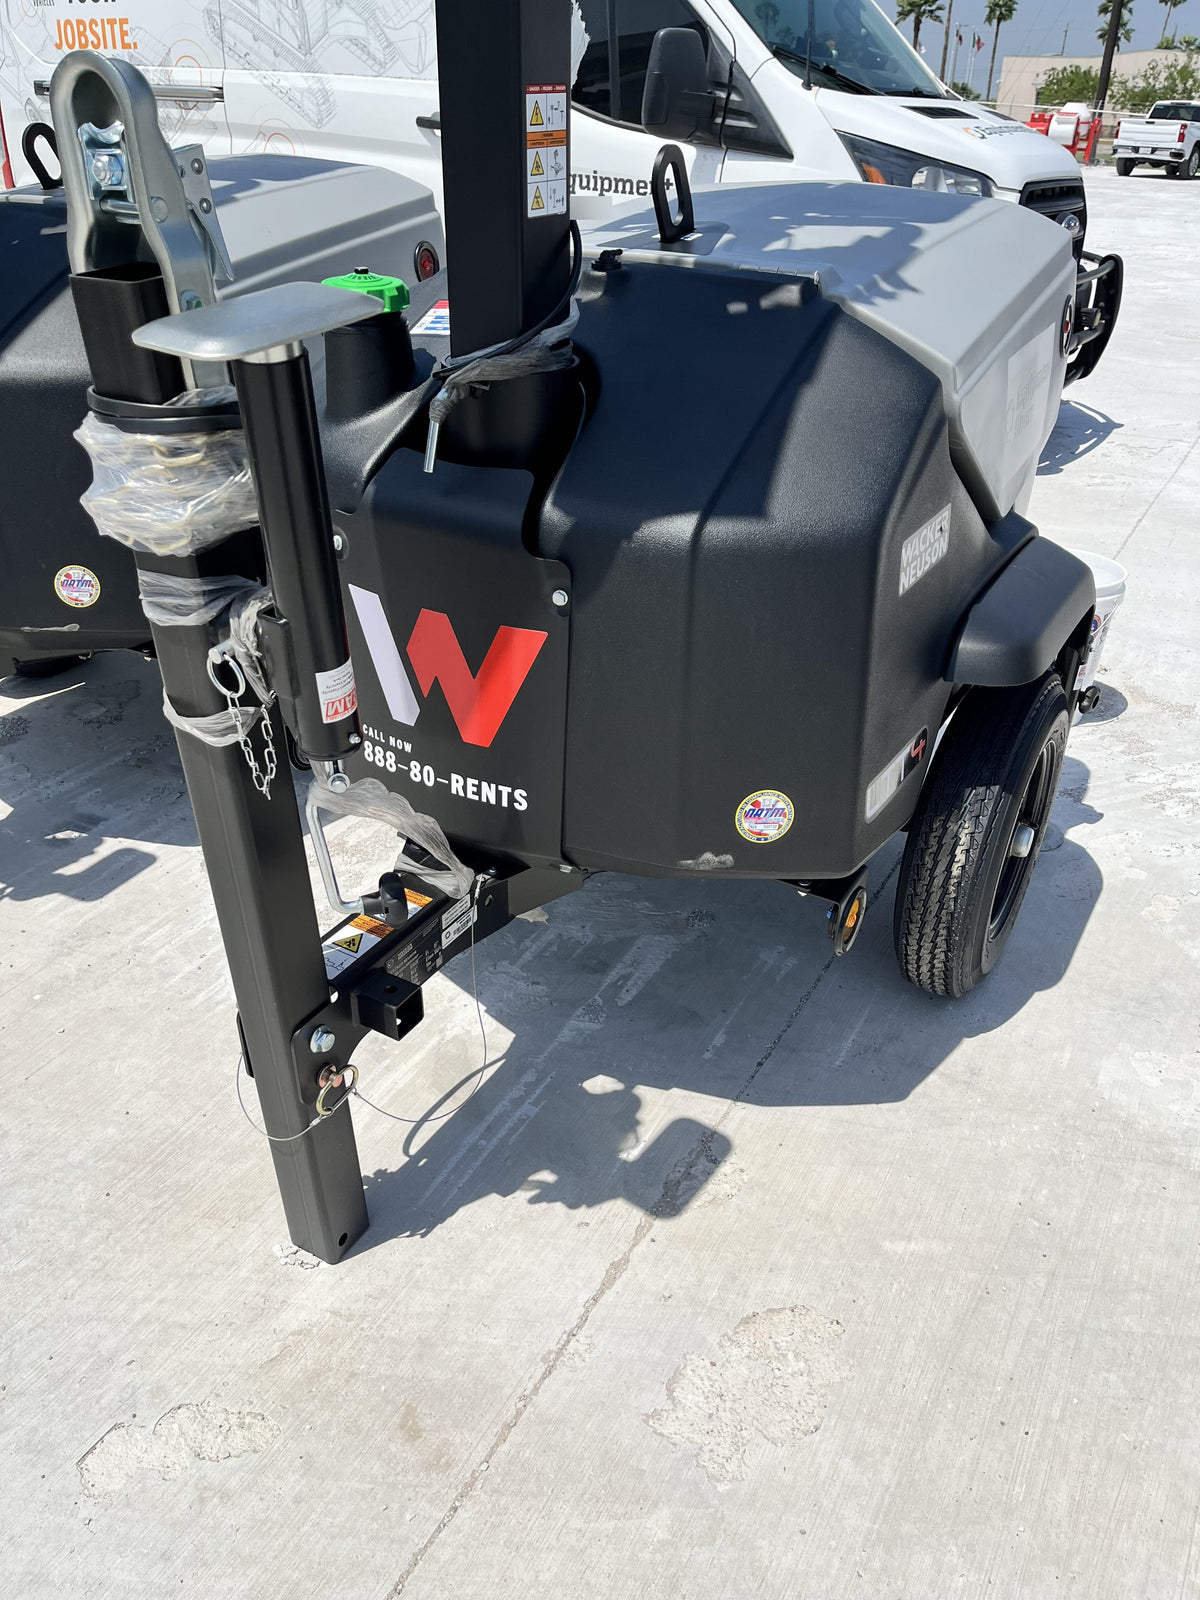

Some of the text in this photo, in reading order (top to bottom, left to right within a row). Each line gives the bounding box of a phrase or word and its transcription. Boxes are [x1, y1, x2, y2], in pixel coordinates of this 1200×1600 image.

[54, 18, 138, 50] JOBSITE.
[900, 533, 949, 594] NEUSON
[902, 510, 949, 567] WACKER
[362, 723, 412, 753] CALL NOW
[363, 740, 528, 811] 888-80-RENTS
